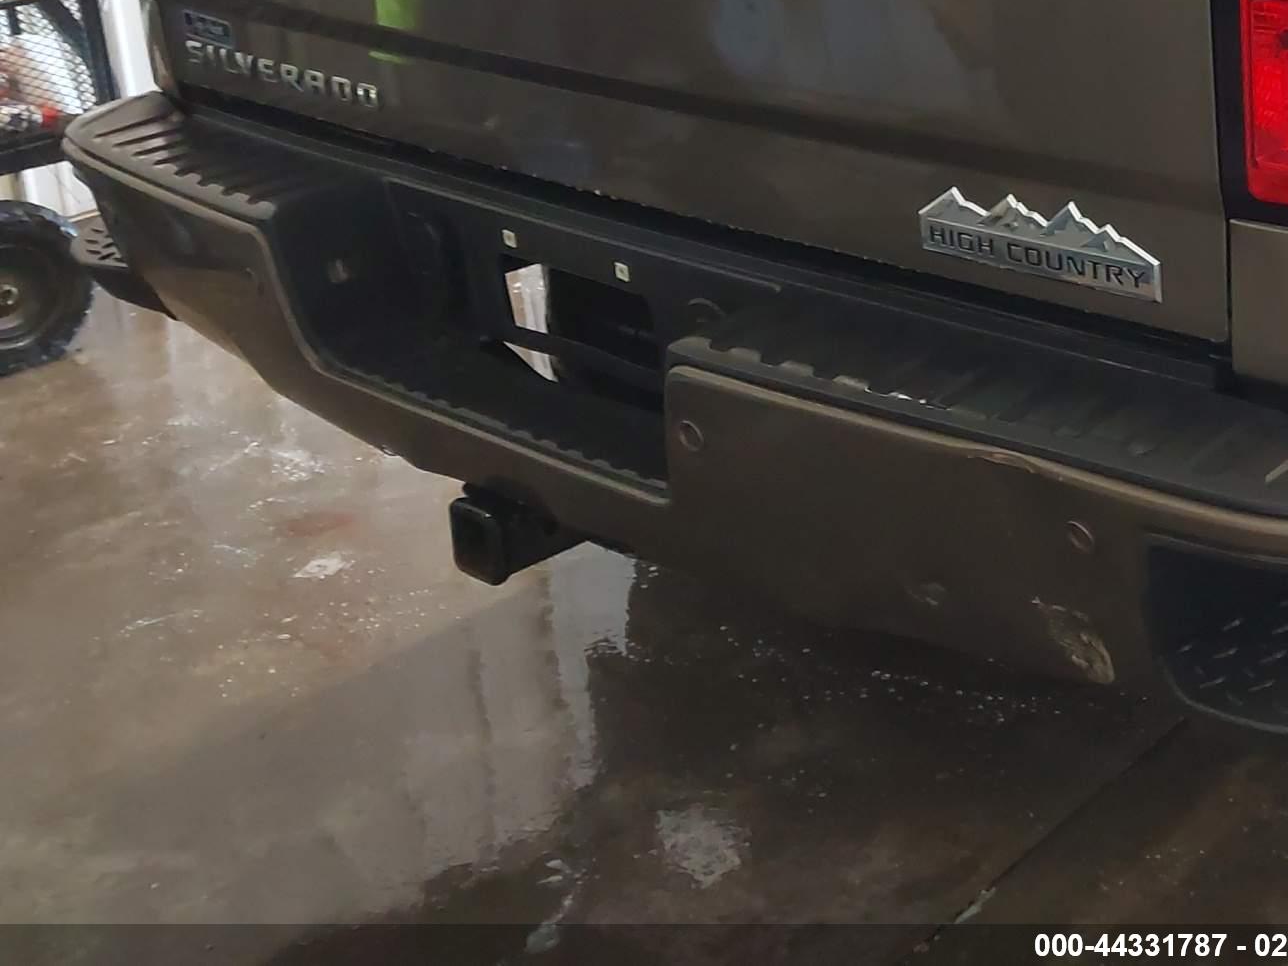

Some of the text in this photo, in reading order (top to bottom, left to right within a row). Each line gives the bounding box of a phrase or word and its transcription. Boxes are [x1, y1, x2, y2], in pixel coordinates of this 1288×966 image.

[184, 39, 379, 109] SILVERADO
[928, 224, 1146, 289] HIGH COUNTRY
